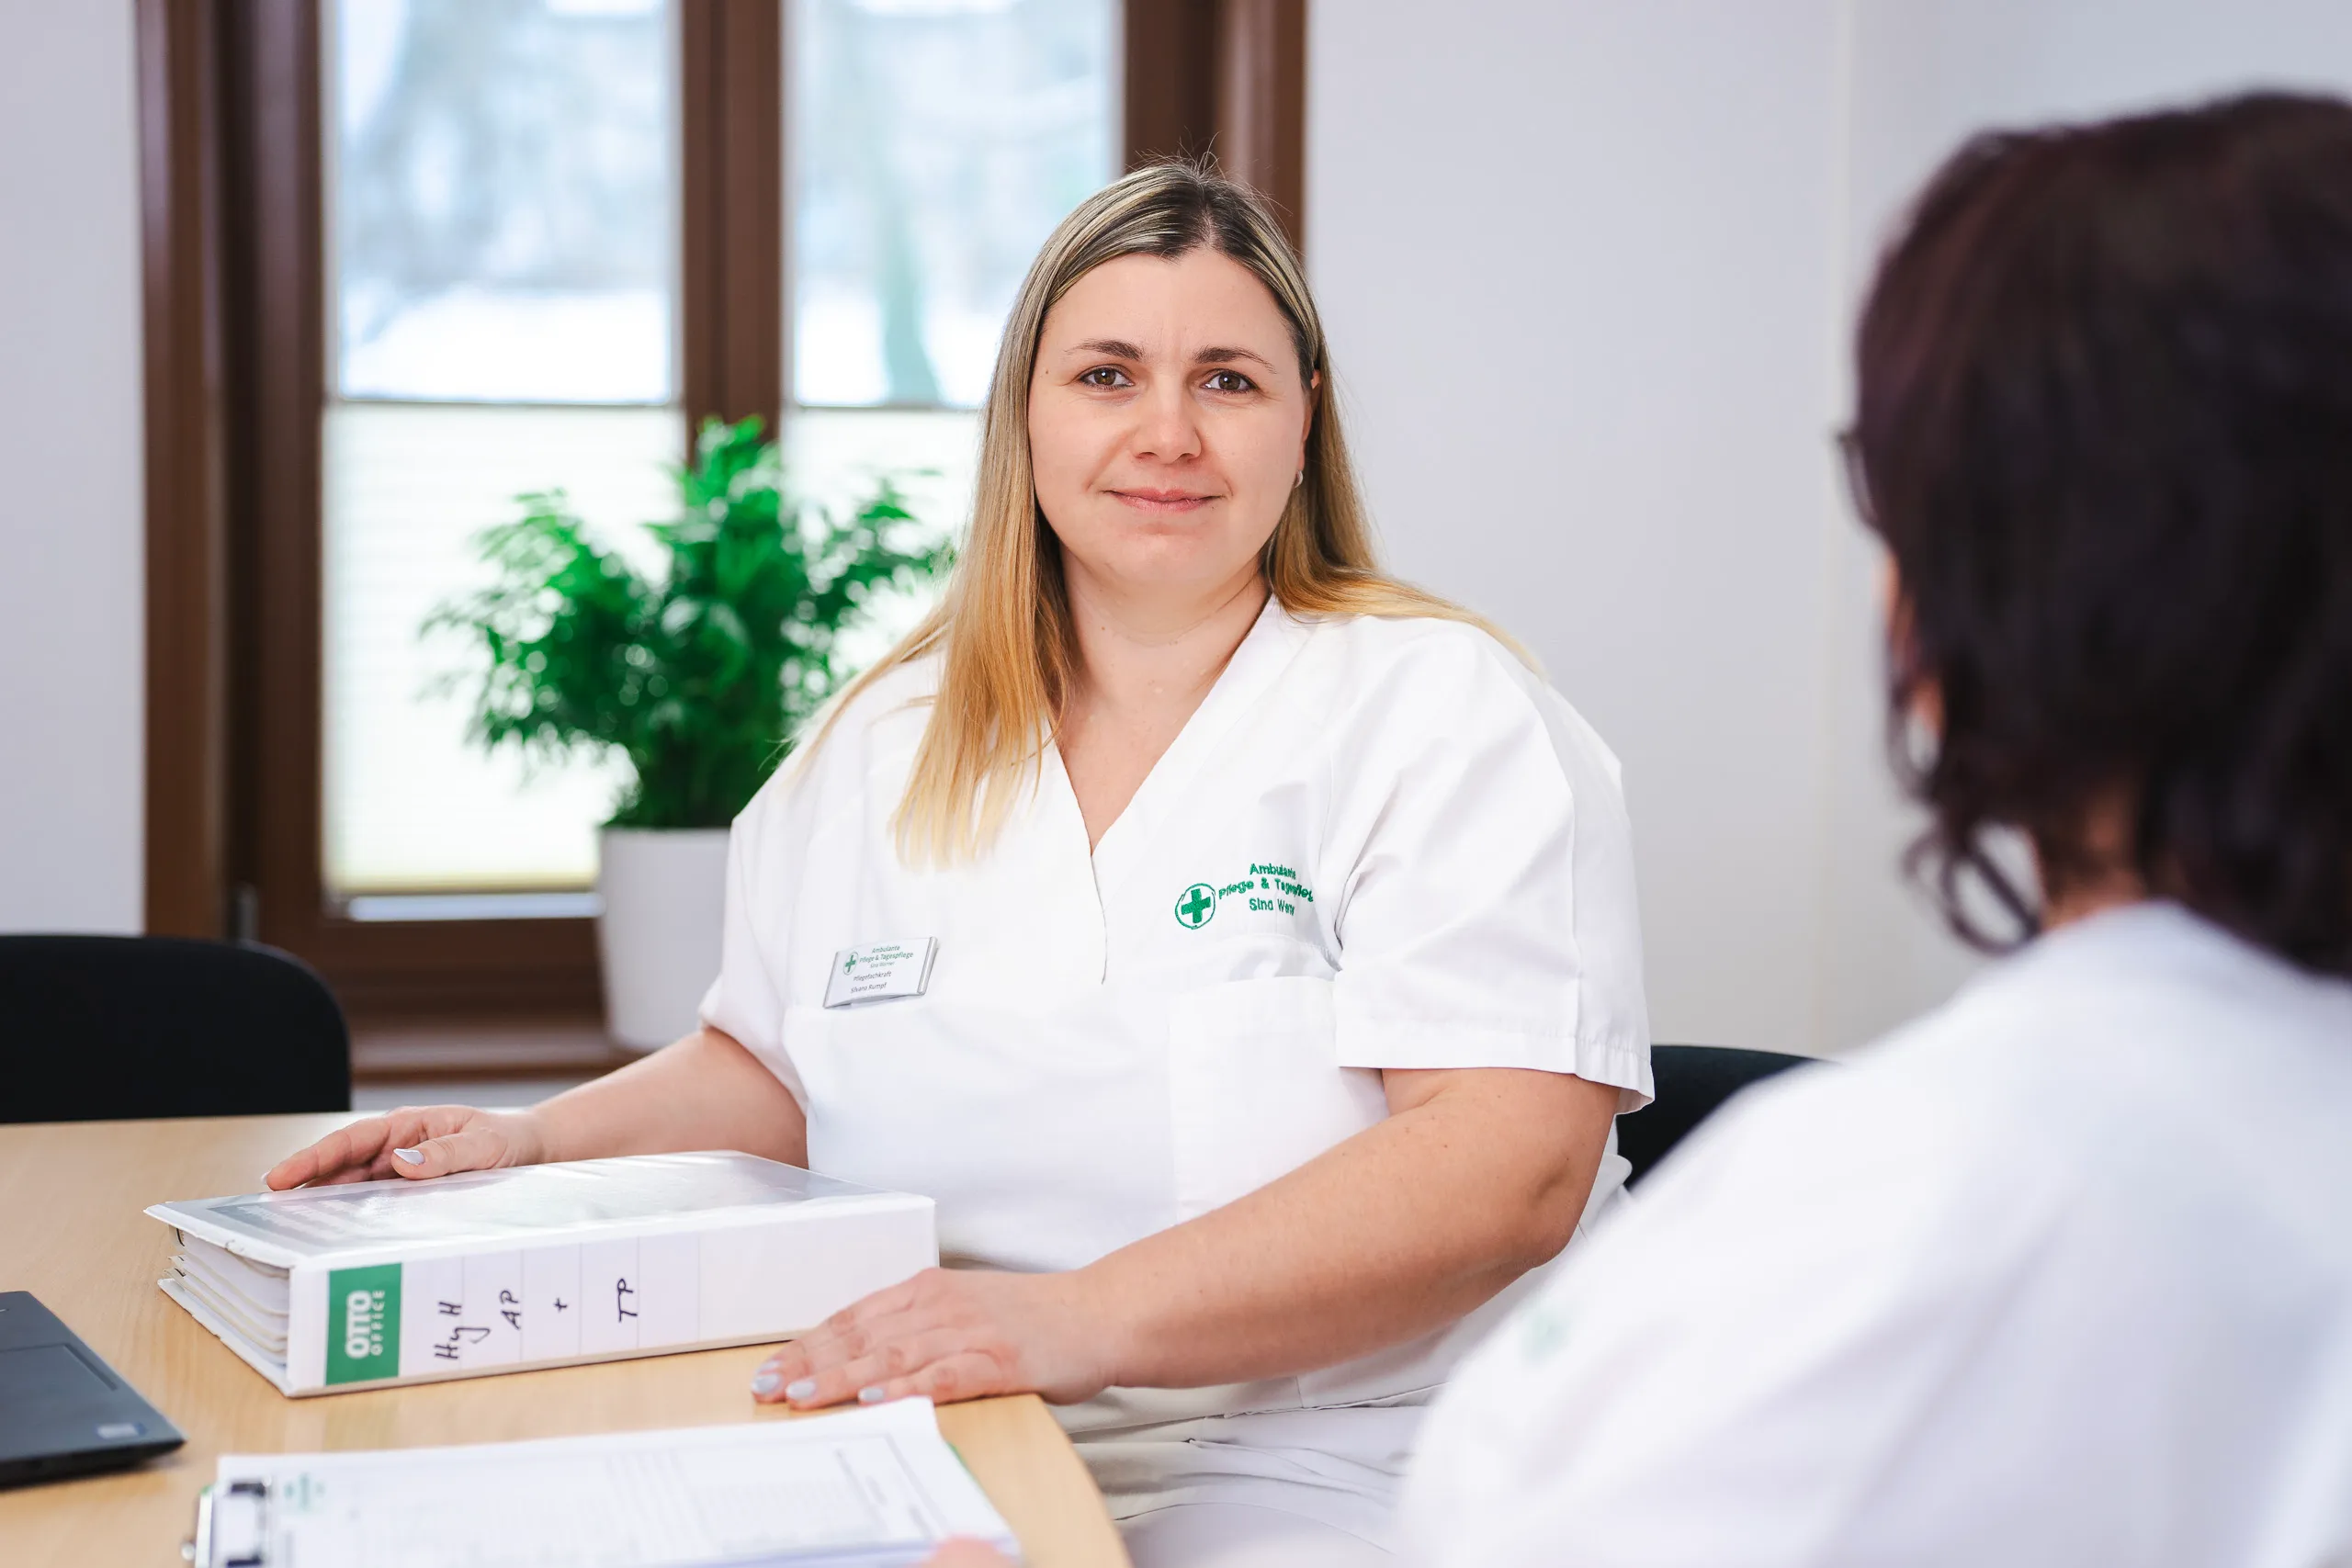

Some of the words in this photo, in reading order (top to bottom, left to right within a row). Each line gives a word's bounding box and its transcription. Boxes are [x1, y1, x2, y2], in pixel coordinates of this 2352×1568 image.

[1249, 897, 1274, 911] Sina
[872, 945, 900, 953] Ambulante
[880, 952, 914, 961] Tagespflege
[499, 1289, 522, 1330] AP
[616, 1277, 639, 1323] TP
[345, 1290, 372, 1359] OTTO
[370, 1290, 386, 1357] OFFICE
